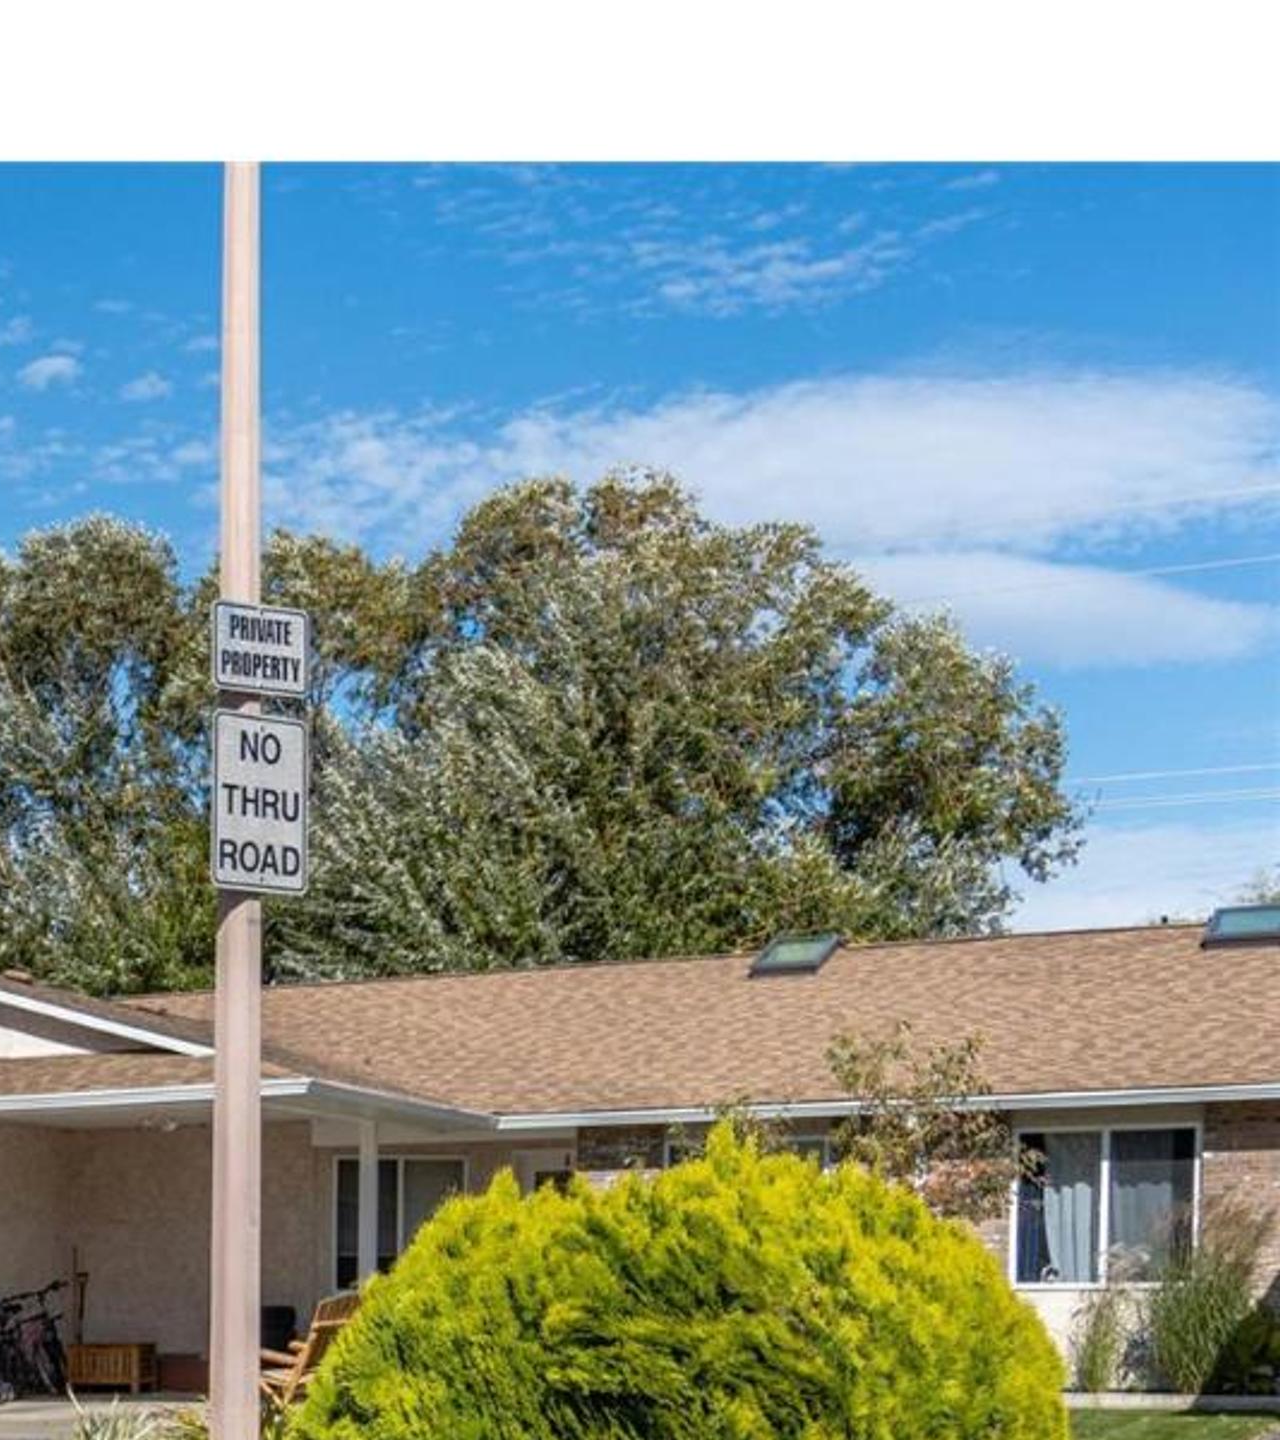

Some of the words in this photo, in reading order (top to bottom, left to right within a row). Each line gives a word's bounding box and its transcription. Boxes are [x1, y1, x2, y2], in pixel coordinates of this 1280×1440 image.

[229, 613, 293, 647] PRIVATE
[221, 649, 301, 683] PROPERTY
[240, 729, 282, 765] NO
[222, 782, 300, 823] THRU
[218, 838, 301, 877] ROAD
